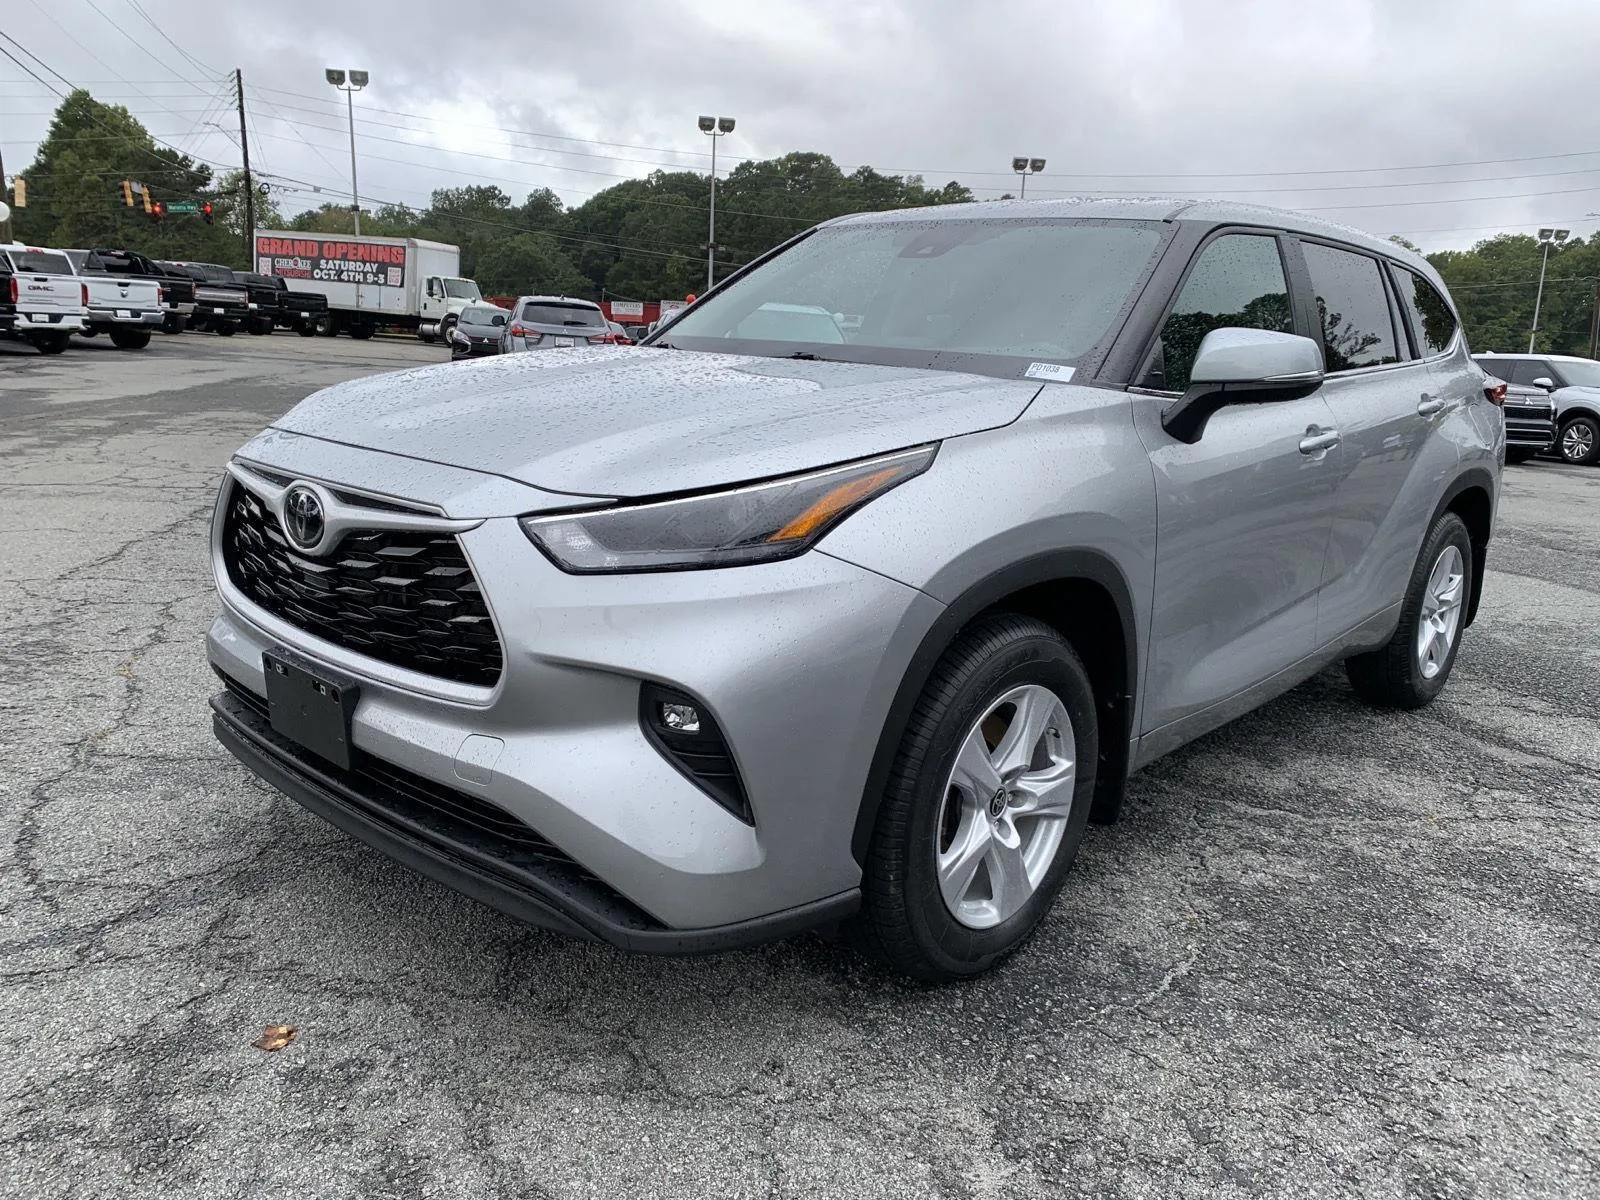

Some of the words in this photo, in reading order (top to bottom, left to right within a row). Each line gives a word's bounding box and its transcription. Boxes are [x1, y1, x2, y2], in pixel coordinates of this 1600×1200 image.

[257, 237, 319, 257] GRAND
[322, 242, 404, 264] OPENING
[274, 257, 312, 269] CHEROKEE
[319, 259, 378, 273] SATURDAY
[313, 269, 338, 280] OCT.
[341, 271, 364, 282] 4TH
[366, 273, 385, 284] 9-3
[1031, 363, 1060, 373] PD1038
